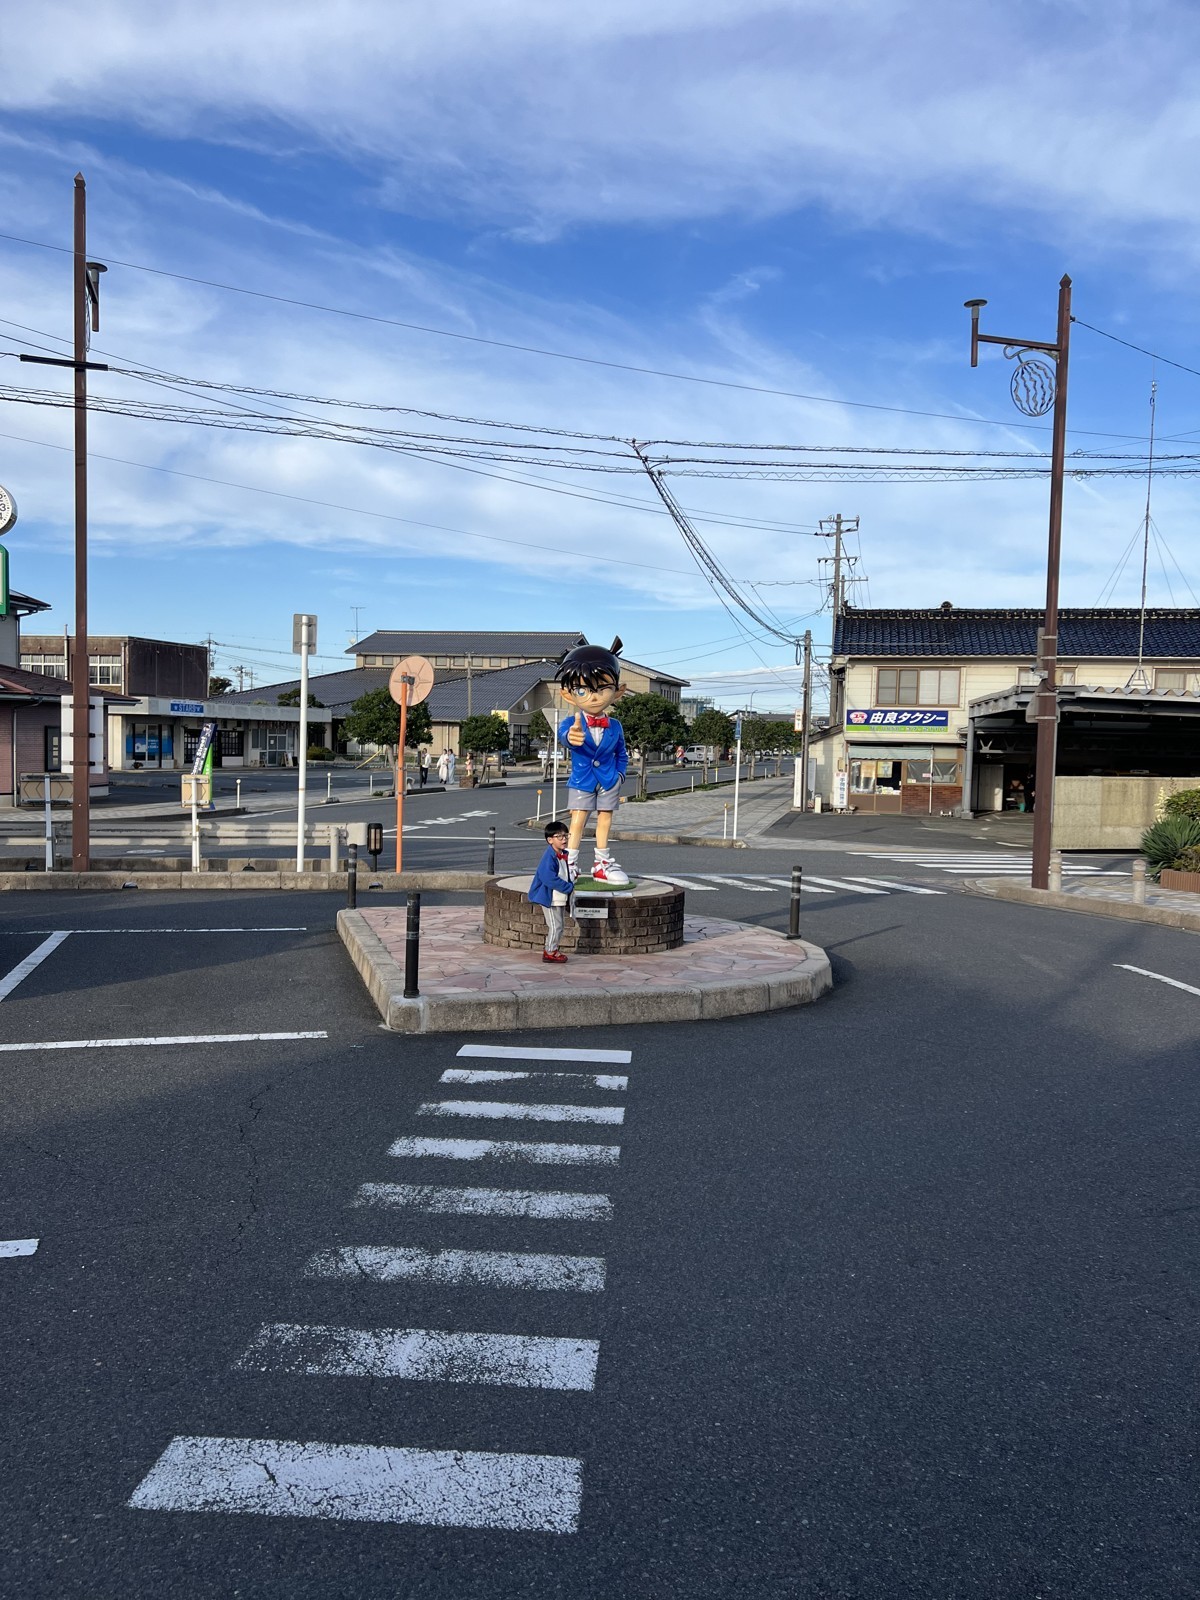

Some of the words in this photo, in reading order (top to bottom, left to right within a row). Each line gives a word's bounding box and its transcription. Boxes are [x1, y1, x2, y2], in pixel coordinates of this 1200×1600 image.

[869, 711, 947, 724] 由良タクシー
[196, 736, 206, 757] Street
